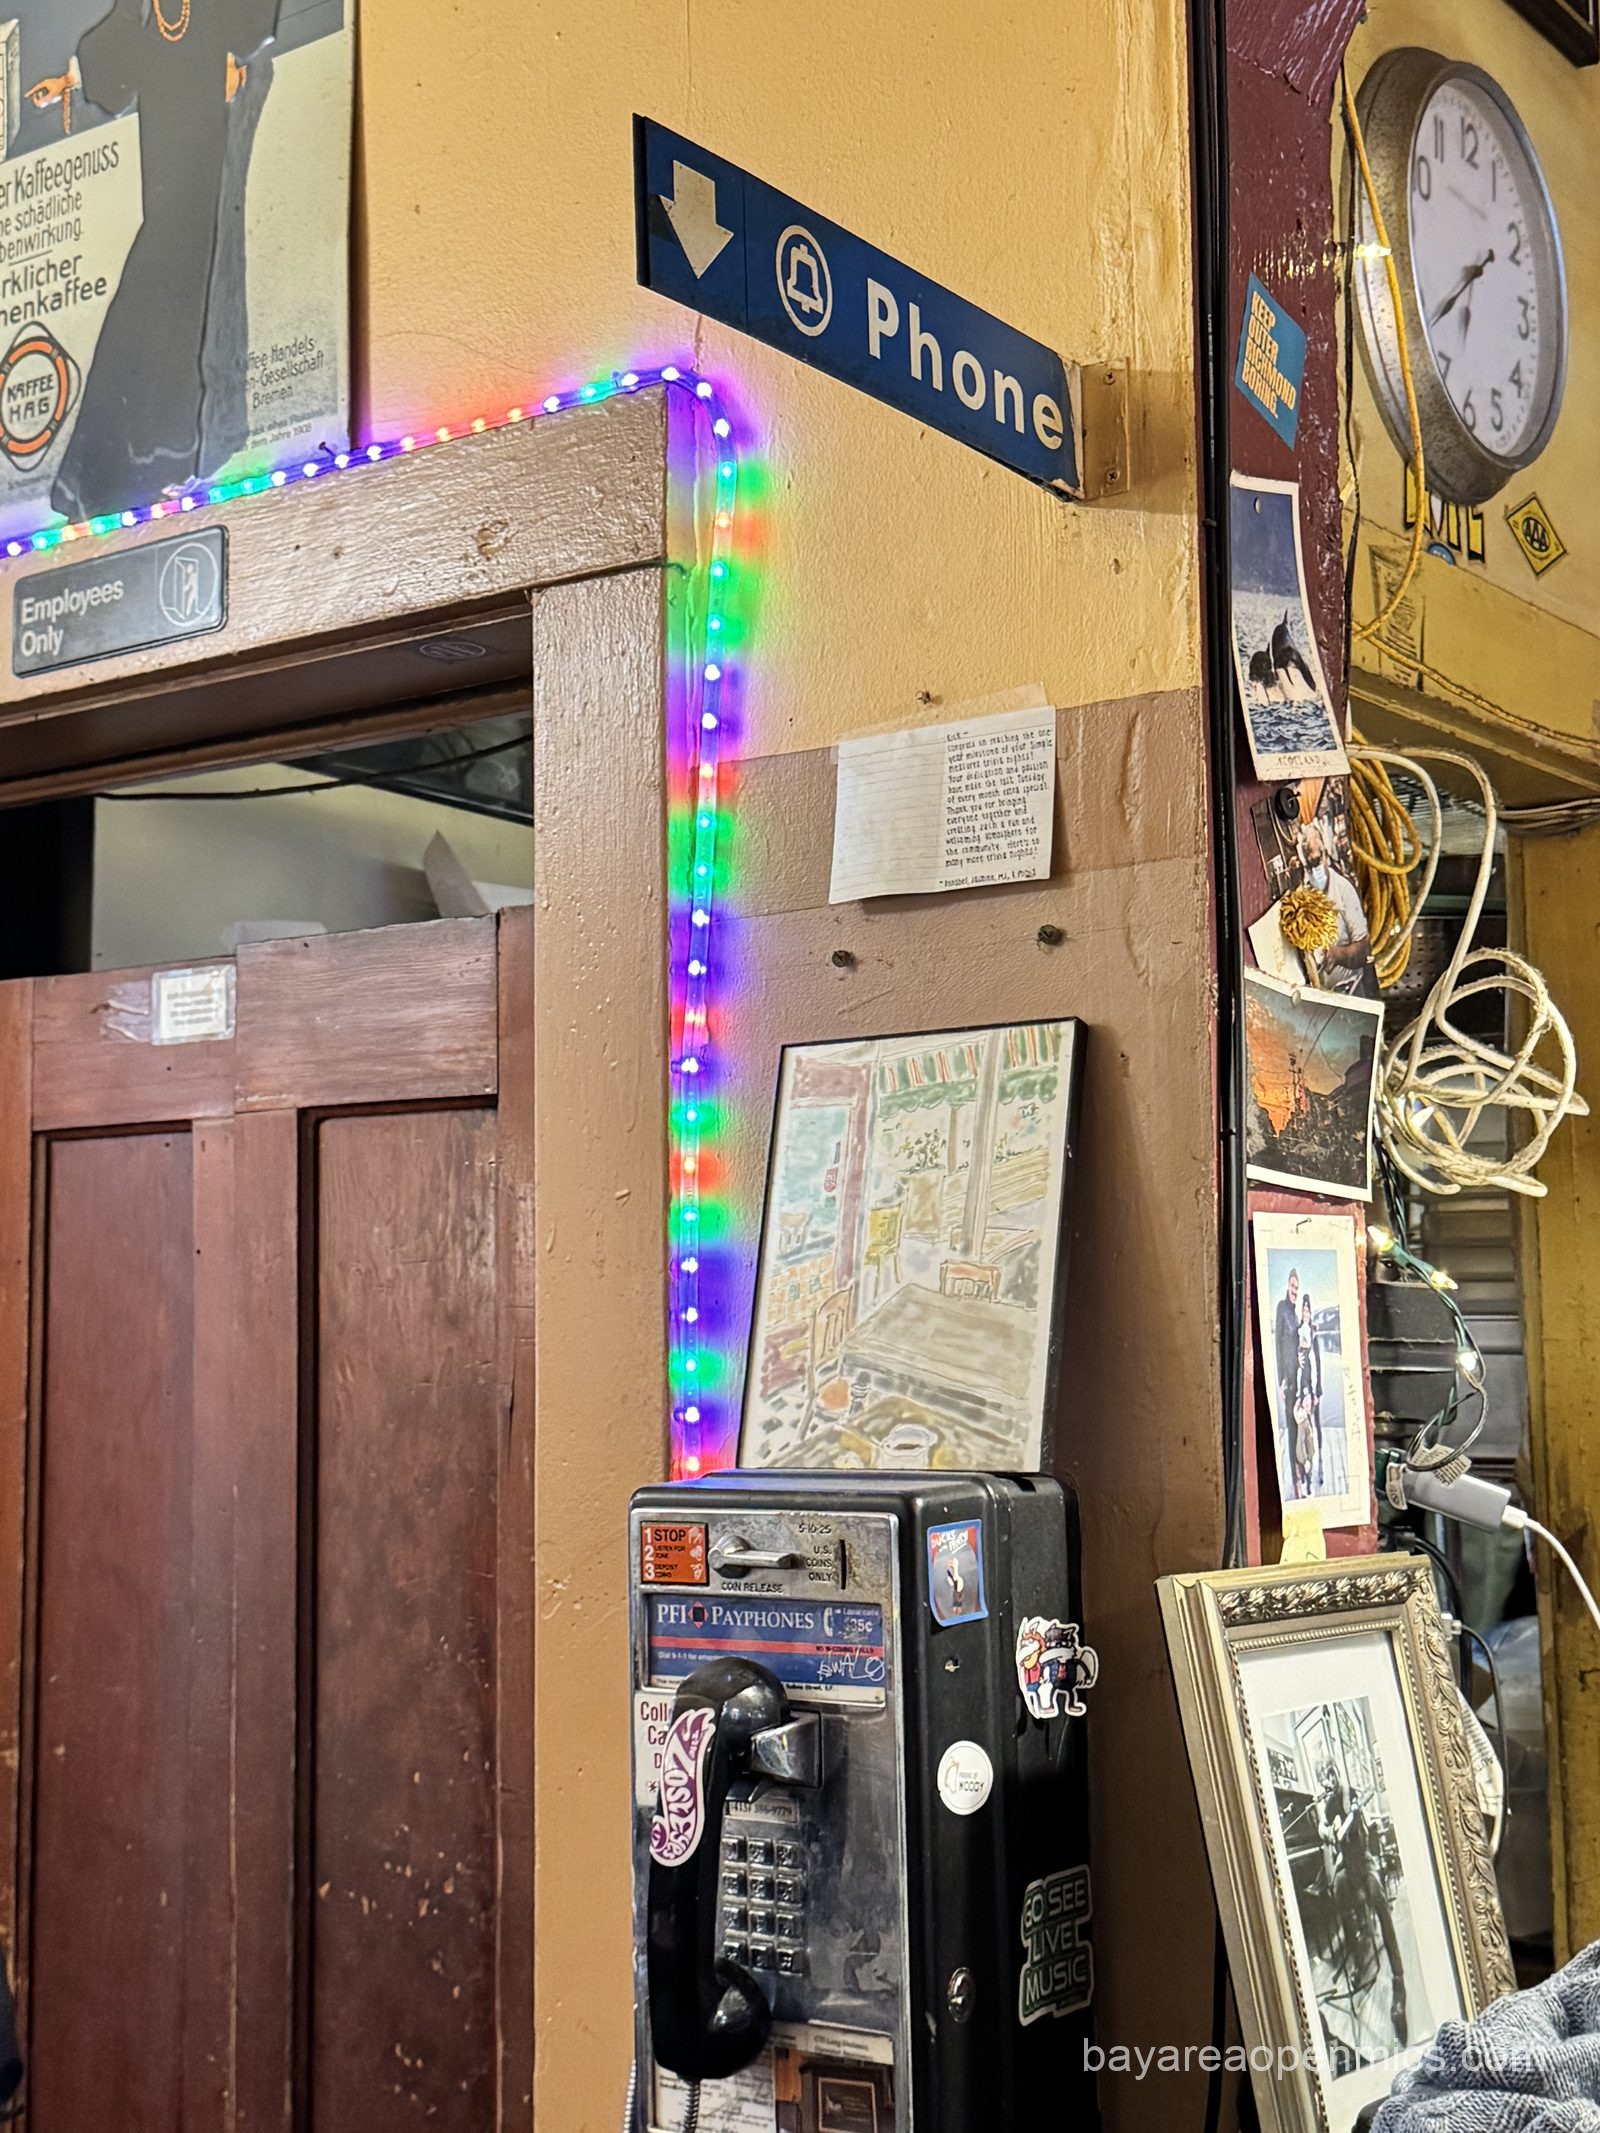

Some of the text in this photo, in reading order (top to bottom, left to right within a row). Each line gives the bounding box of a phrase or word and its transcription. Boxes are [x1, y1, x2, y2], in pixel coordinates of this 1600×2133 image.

[1434, 115, 1479, 170] 11 12
[0, 141, 119, 210] er Kaffeegenuss
[1491, 160, 1497, 202] 1
[0, 217, 11, 237] ne
[0, 218, 84, 263] benwirkung.
[1508, 222, 1521, 267] 2
[1, 254, 82, 299] rklicher
[0, 276, 107, 327] nenkaffee
[1251, 291, 1276, 329] KEEP
[1517, 295, 1530, 340] 3
[1248, 314, 1279, 366] OUTER
[867, 277, 1064, 450] Phone
[1245, 336, 1296, 411] RICHMOND
[1438, 351, 1452, 382] 7
[1508, 359, 1522, 398] 4
[7, 373, 55, 403] KAFFEE
[10, 397, 50, 423] HAG
[1463, 386, 1476, 432] 6
[1490, 388, 1503, 432] 5
[20, 579, 124, 625] Employees
[20, 625, 64, 657] Only
[644, 1528, 686, 1544] 1 STOP
[644, 1544, 654, 1561] 2
[813, 1545, 832, 1555] U.S.
[644, 1563, 655, 1580] 3
[805, 1558, 833, 1568] COINS
[808, 1572, 834, 1582] ONLY
[721, 1582, 784, 1594] COIN RELEASE
[657, 1604, 815, 1630] PFI PAYPHONES
[640, 1701, 671, 1721] Coll
[1024, 1878, 1086, 1929] GO SEE
[1031, 1922, 1073, 1963] LIVE
[1025, 1954, 1087, 2006] MUSIC
